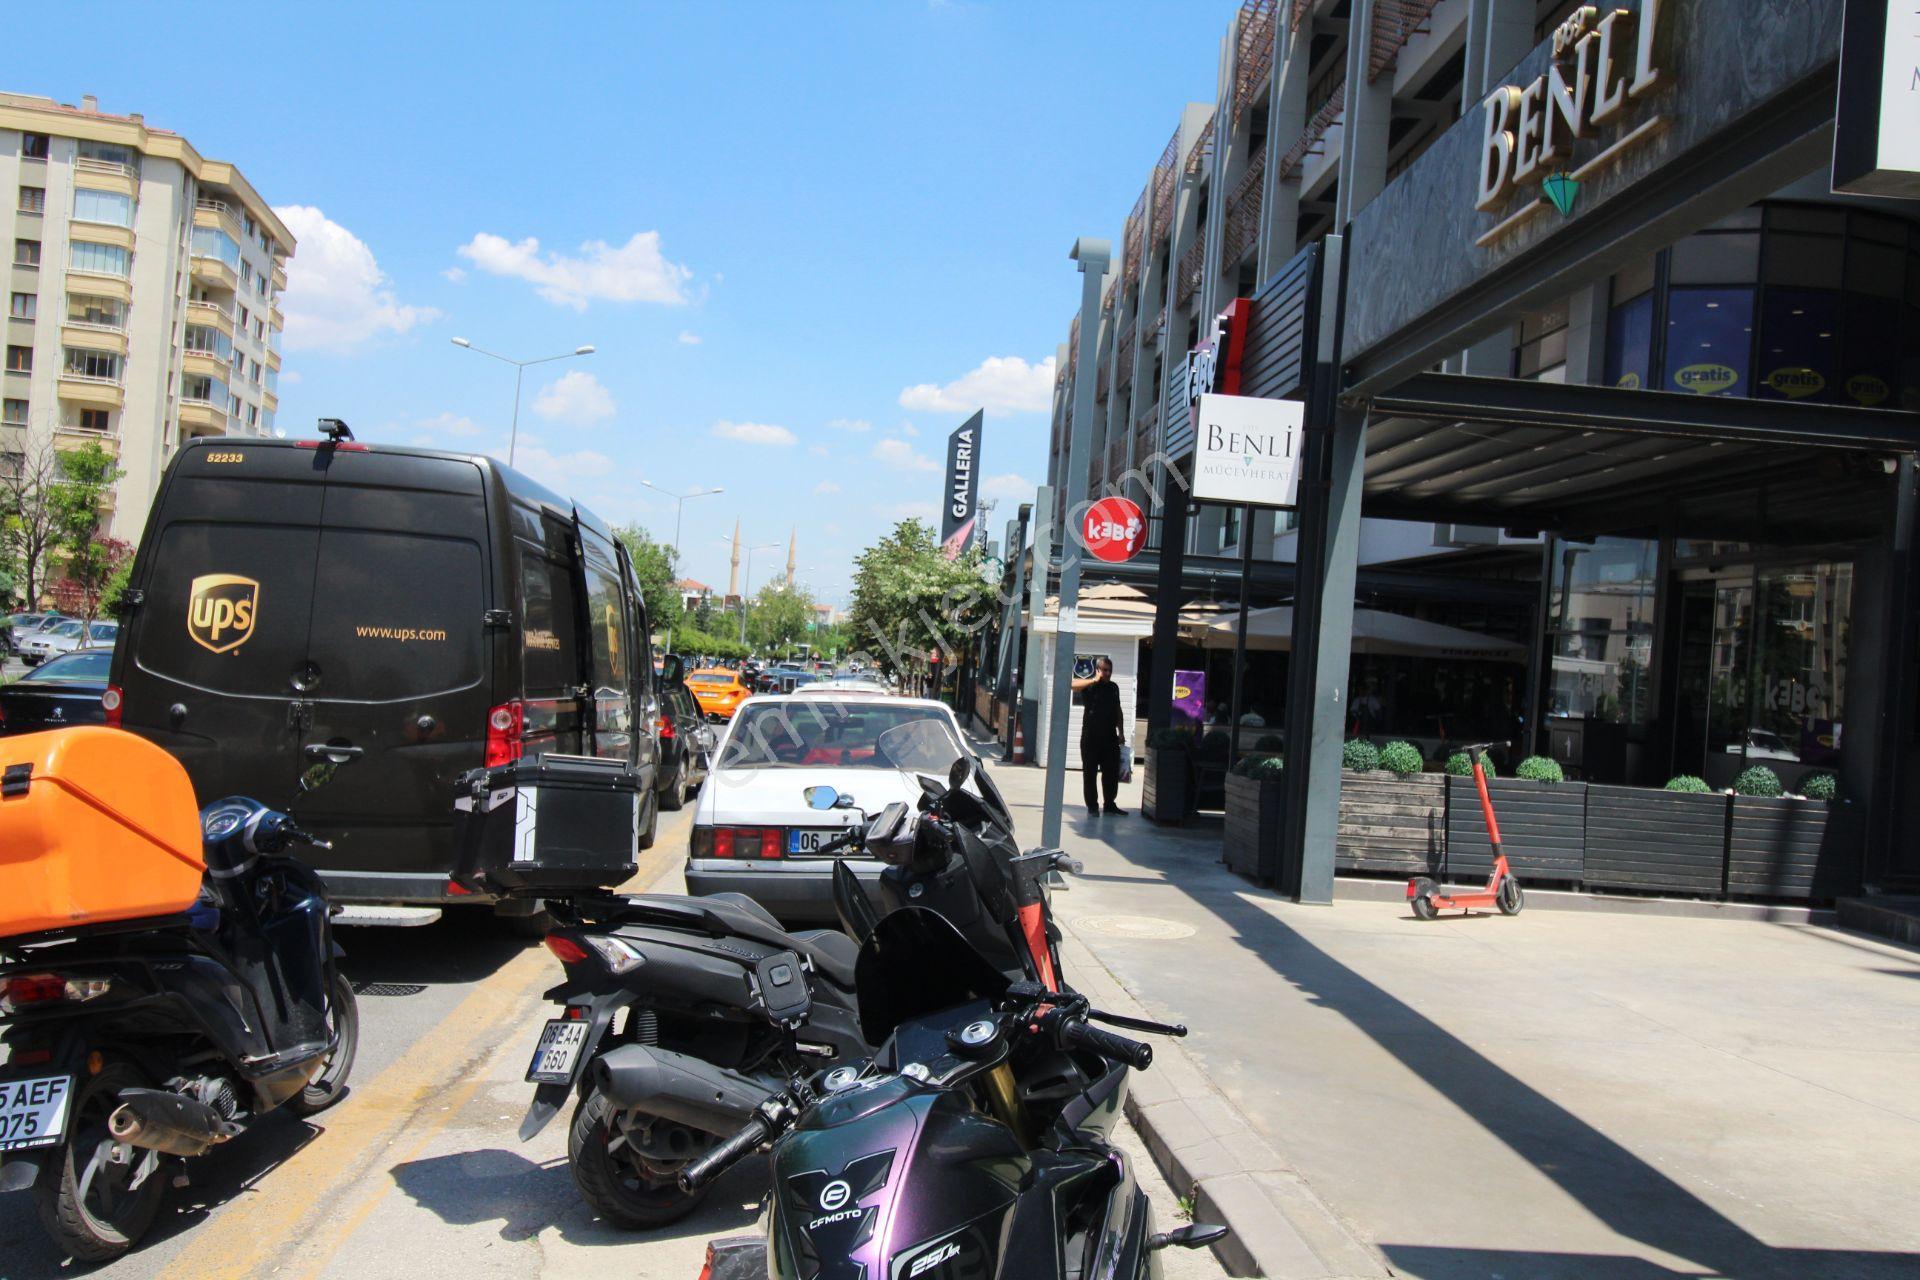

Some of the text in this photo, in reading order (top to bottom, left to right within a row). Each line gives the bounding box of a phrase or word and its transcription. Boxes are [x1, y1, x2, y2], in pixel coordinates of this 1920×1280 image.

[1681, 367, 1731, 384] gratis
[206, 453, 244, 463] 52233
[952, 428, 973, 518] GALLERIA
[193, 598, 252, 640] ups
[356, 625, 446, 642] www.ups.com
[801, 833, 819, 850] 06
[544, 1050, 568, 1070] 560
[12, 1078, 67, 1108] AEF
[809, 1209, 862, 1230] CFMOTO
